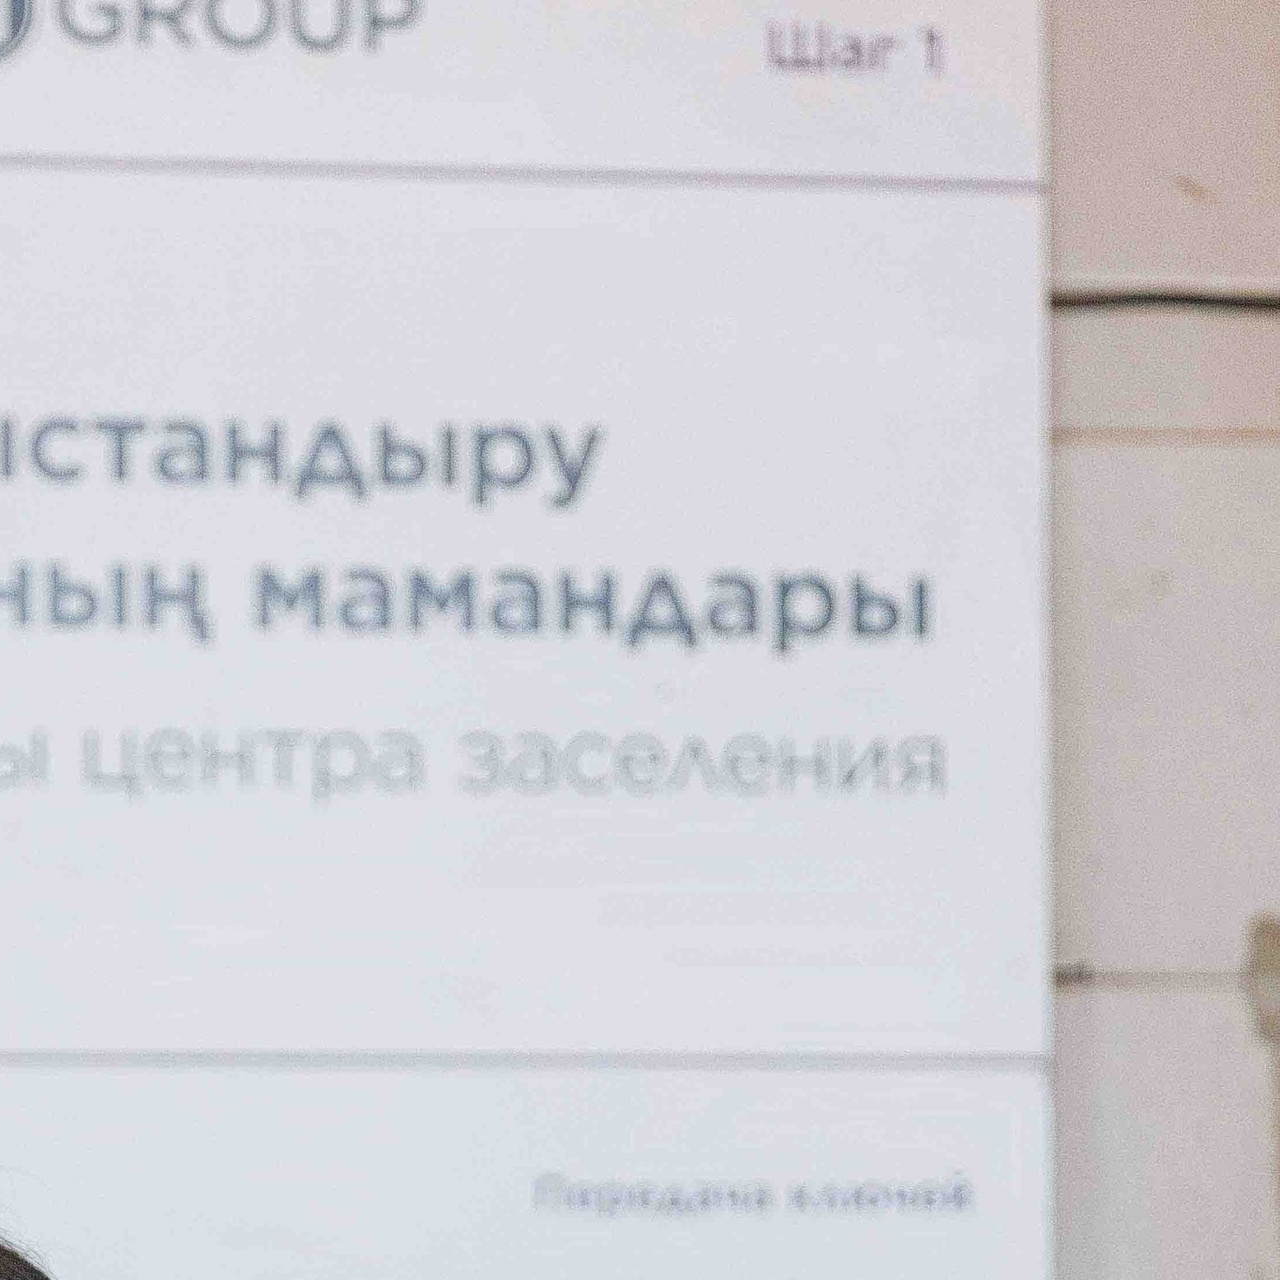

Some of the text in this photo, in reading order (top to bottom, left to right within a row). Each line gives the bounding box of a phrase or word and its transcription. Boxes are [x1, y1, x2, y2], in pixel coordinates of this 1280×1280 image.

[58, 0, 422, 53] GROUP
[766, 20, 947, 75] Шаг 1
[255, 562, 932, 654] мамандары
[82, 720, 426, 800] центра
[458, 726, 946, 796] заселения
